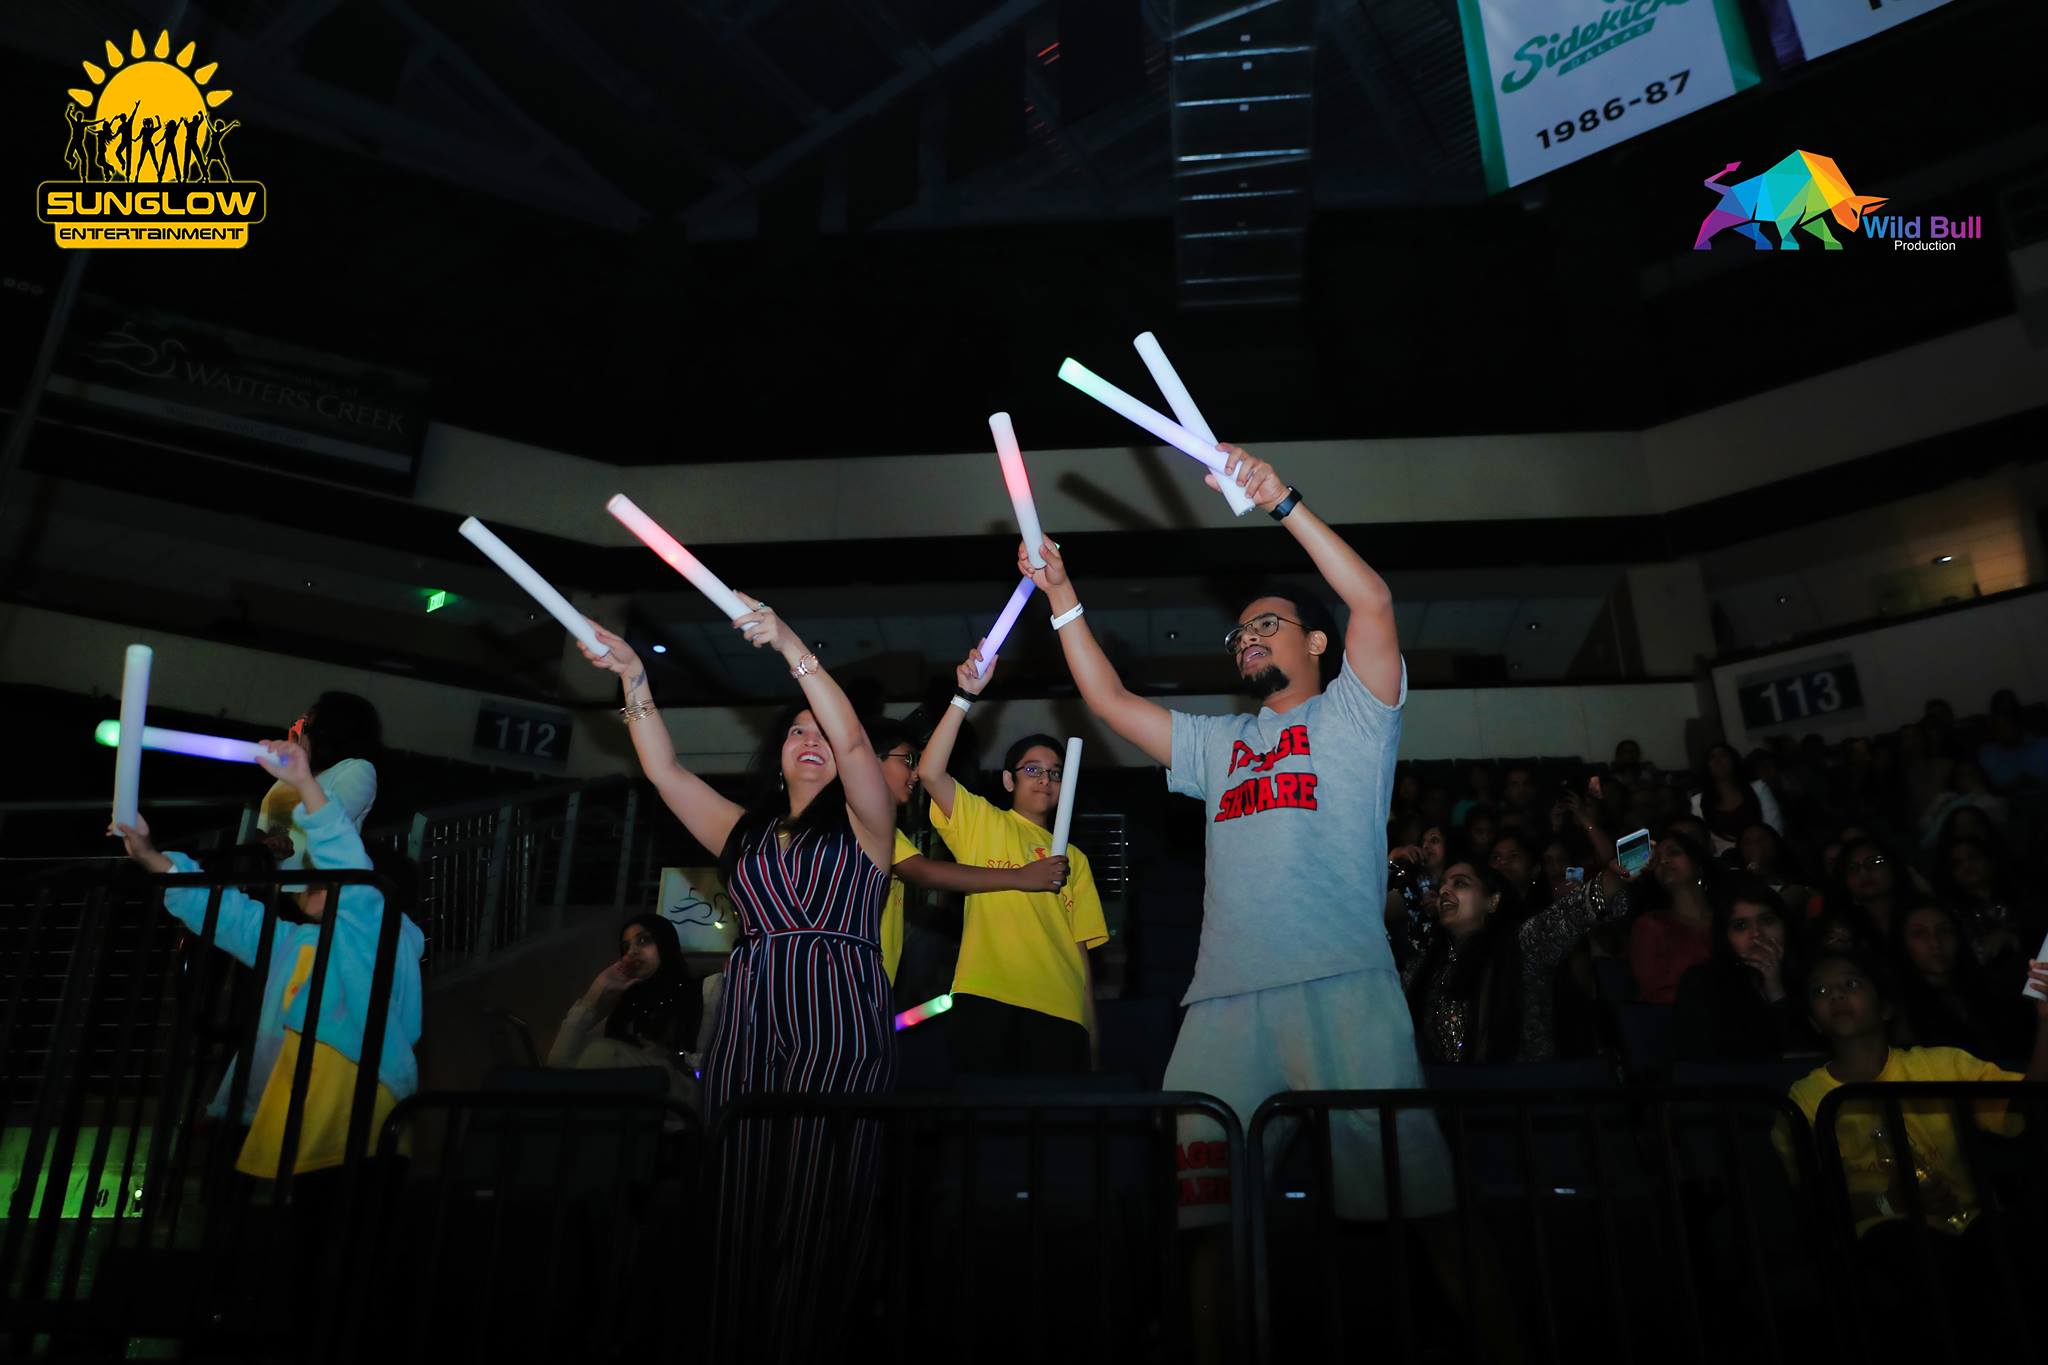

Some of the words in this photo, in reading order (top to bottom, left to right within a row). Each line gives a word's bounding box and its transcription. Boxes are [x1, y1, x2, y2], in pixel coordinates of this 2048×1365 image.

[1501, 0, 1690, 93] Sidekic
[1536, 69, 1691, 149] 1986-87
[184, 360, 312, 409] WATTERS
[316, 394, 406, 434] CREEK
[1760, 671, 1843, 723] 113
[496, 714, 557, 757] 112
